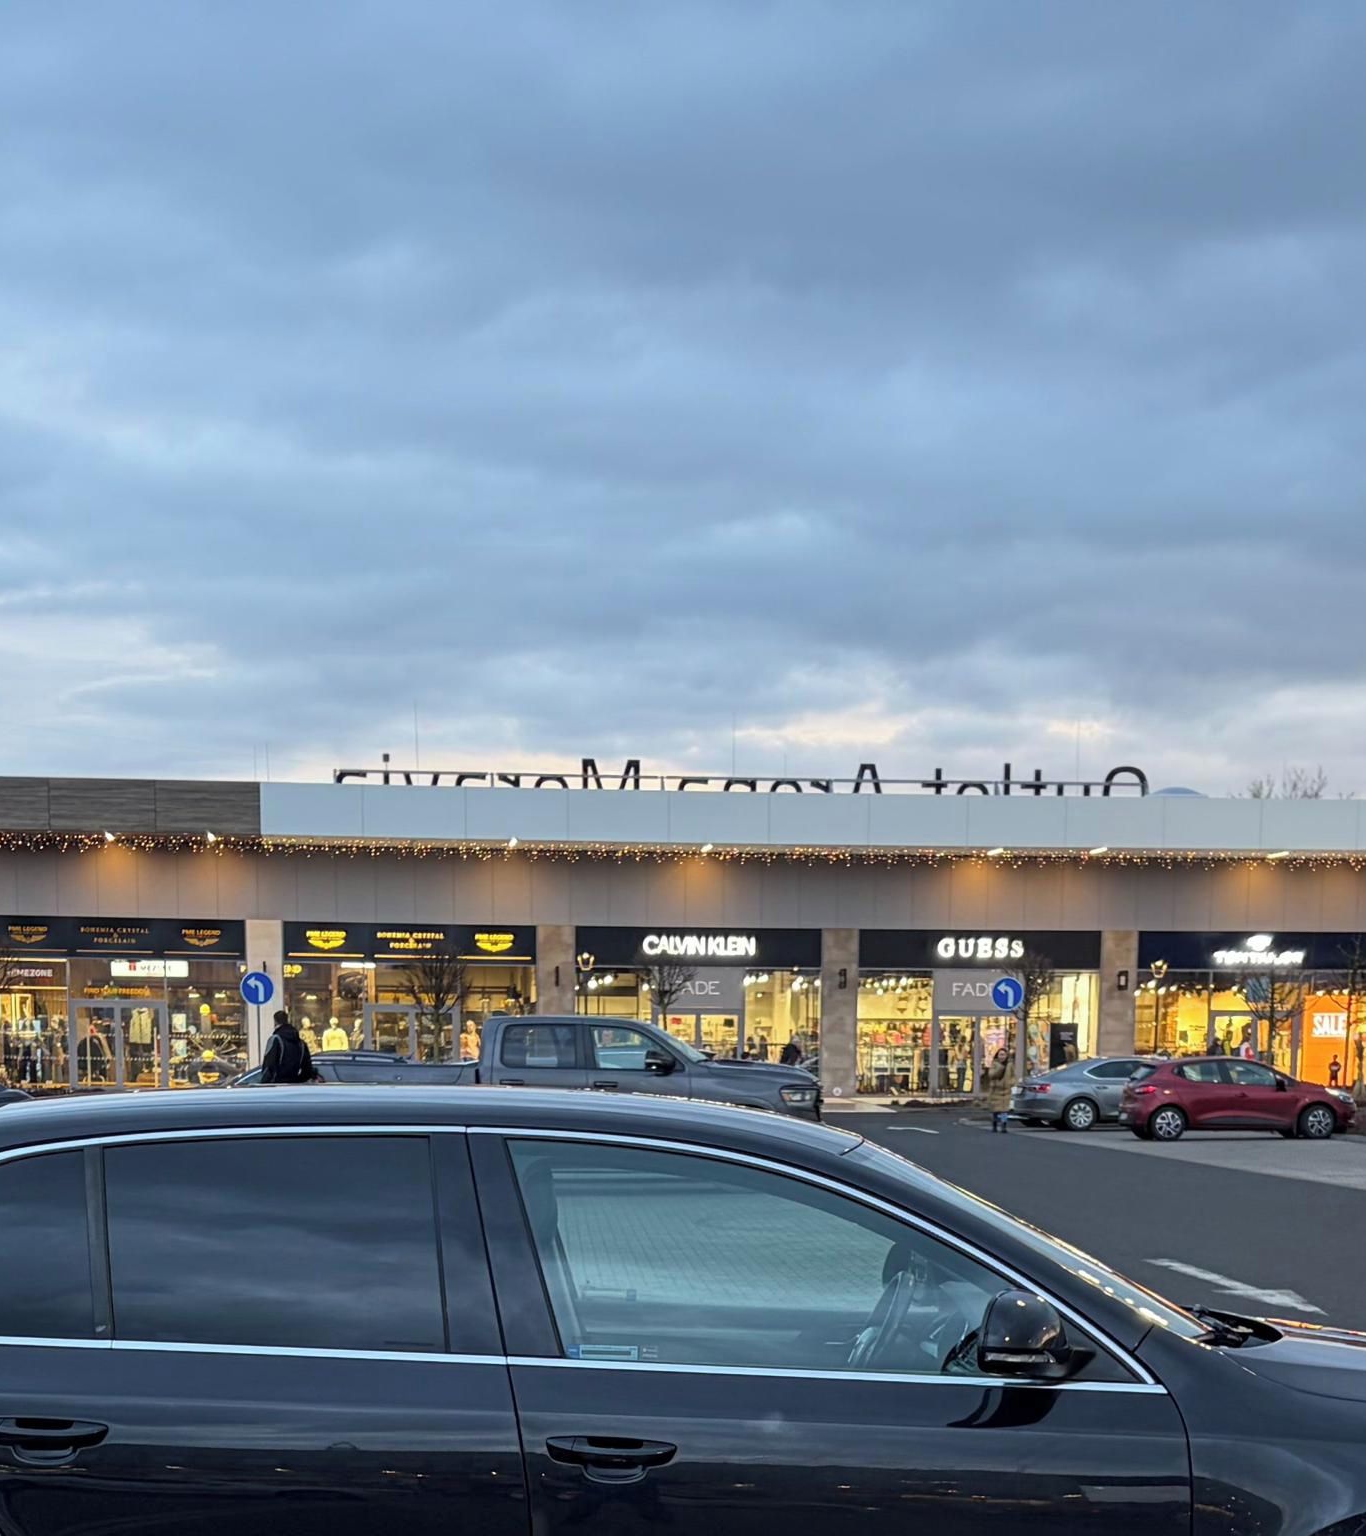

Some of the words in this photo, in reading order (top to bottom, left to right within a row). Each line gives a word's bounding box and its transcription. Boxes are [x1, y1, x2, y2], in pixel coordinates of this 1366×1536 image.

[642, 935, 706, 956] CALVIN
[707, 936, 756, 956] KLEIN
[937, 937, 1024, 958] GUESS
